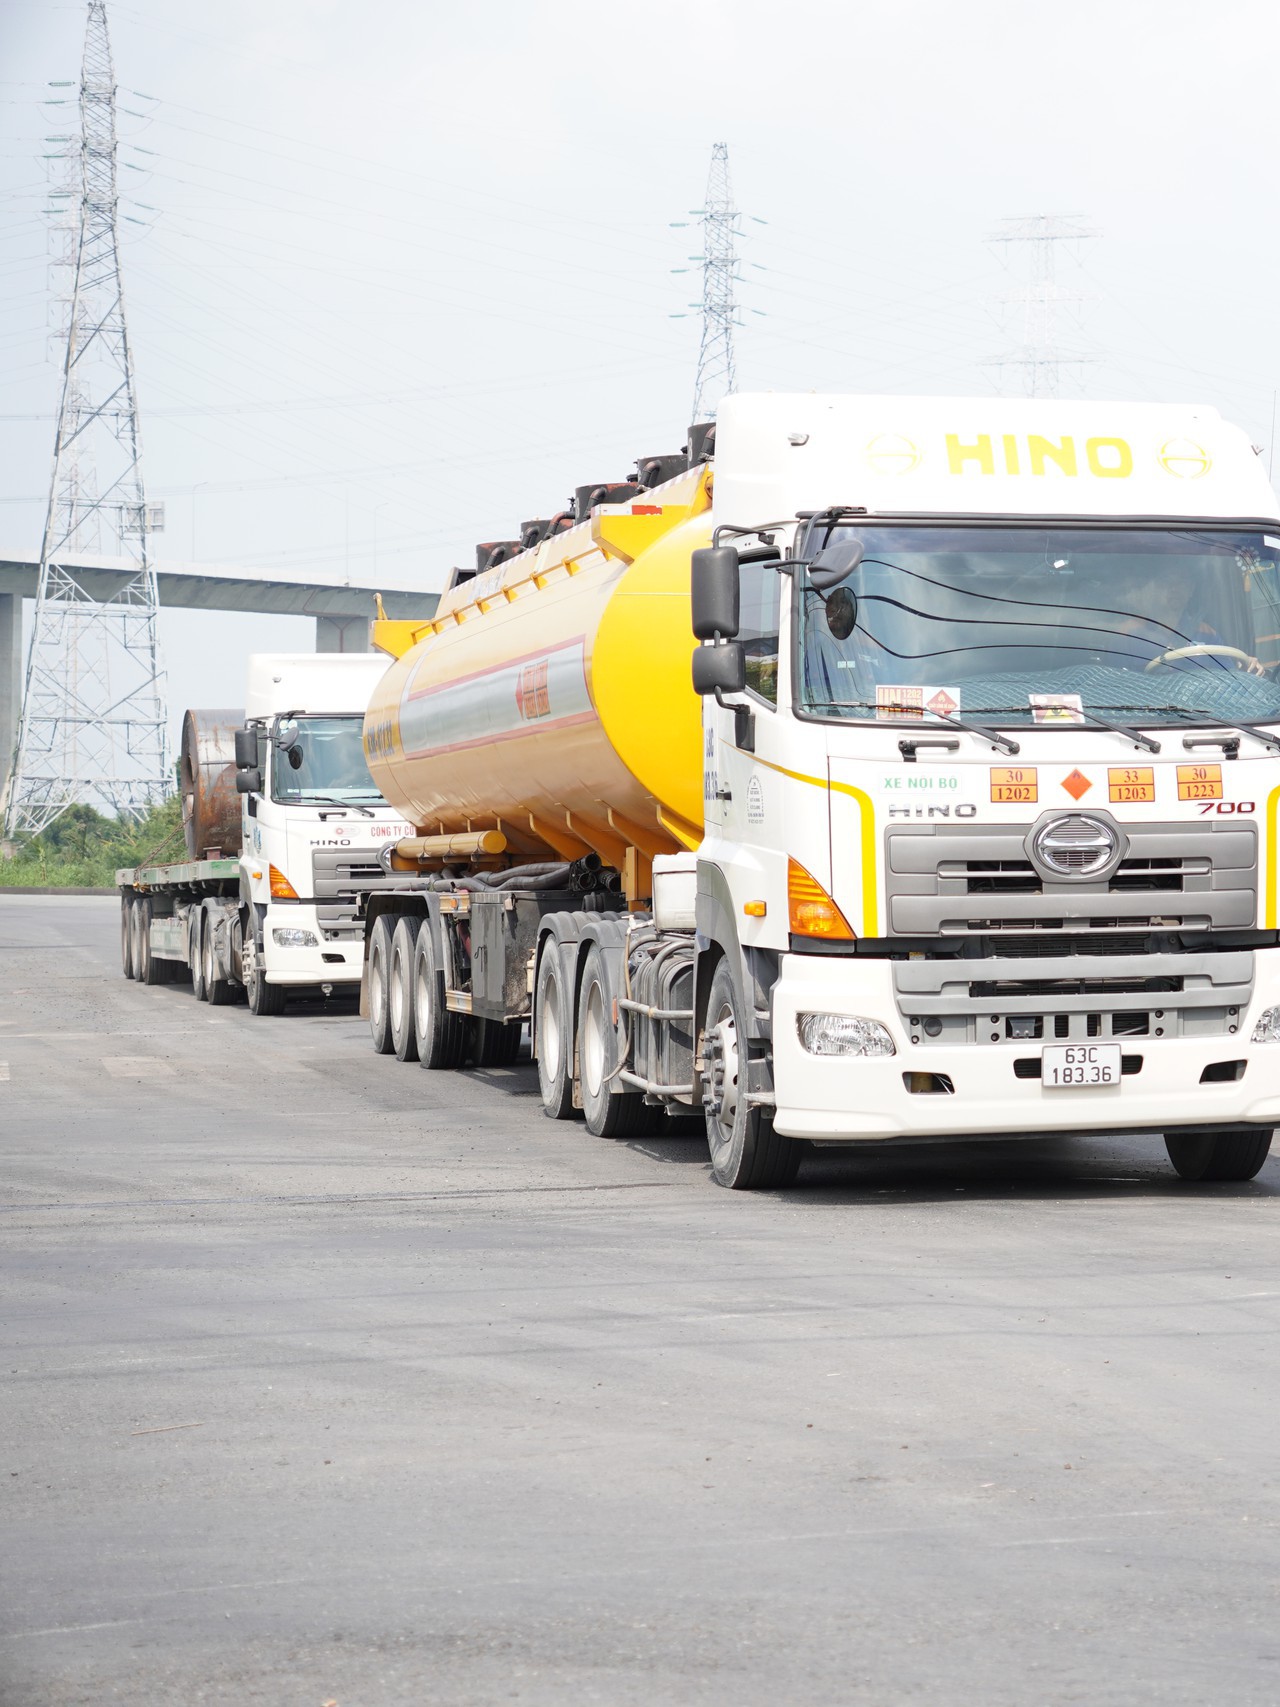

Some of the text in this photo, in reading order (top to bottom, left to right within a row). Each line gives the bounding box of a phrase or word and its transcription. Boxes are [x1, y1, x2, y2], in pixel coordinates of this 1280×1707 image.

[944, 433, 1134, 479] HINO
[1005, 770, 1023, 783] 30
[1123, 770, 1139, 783] 33
[1191, 768, 1207, 781] 30
[883, 777, 902, 789] XE
[997, 787, 1031, 800] 1202
[1117, 787, 1147, 800] 1203
[1186, 784, 1215, 798] 1223
[888, 803, 977, 818] HINO
[1196, 801, 1256, 815] 700
[1065, 1047, 1098, 1064] 63C
[1053, 1066, 1112, 1084] 183.36
